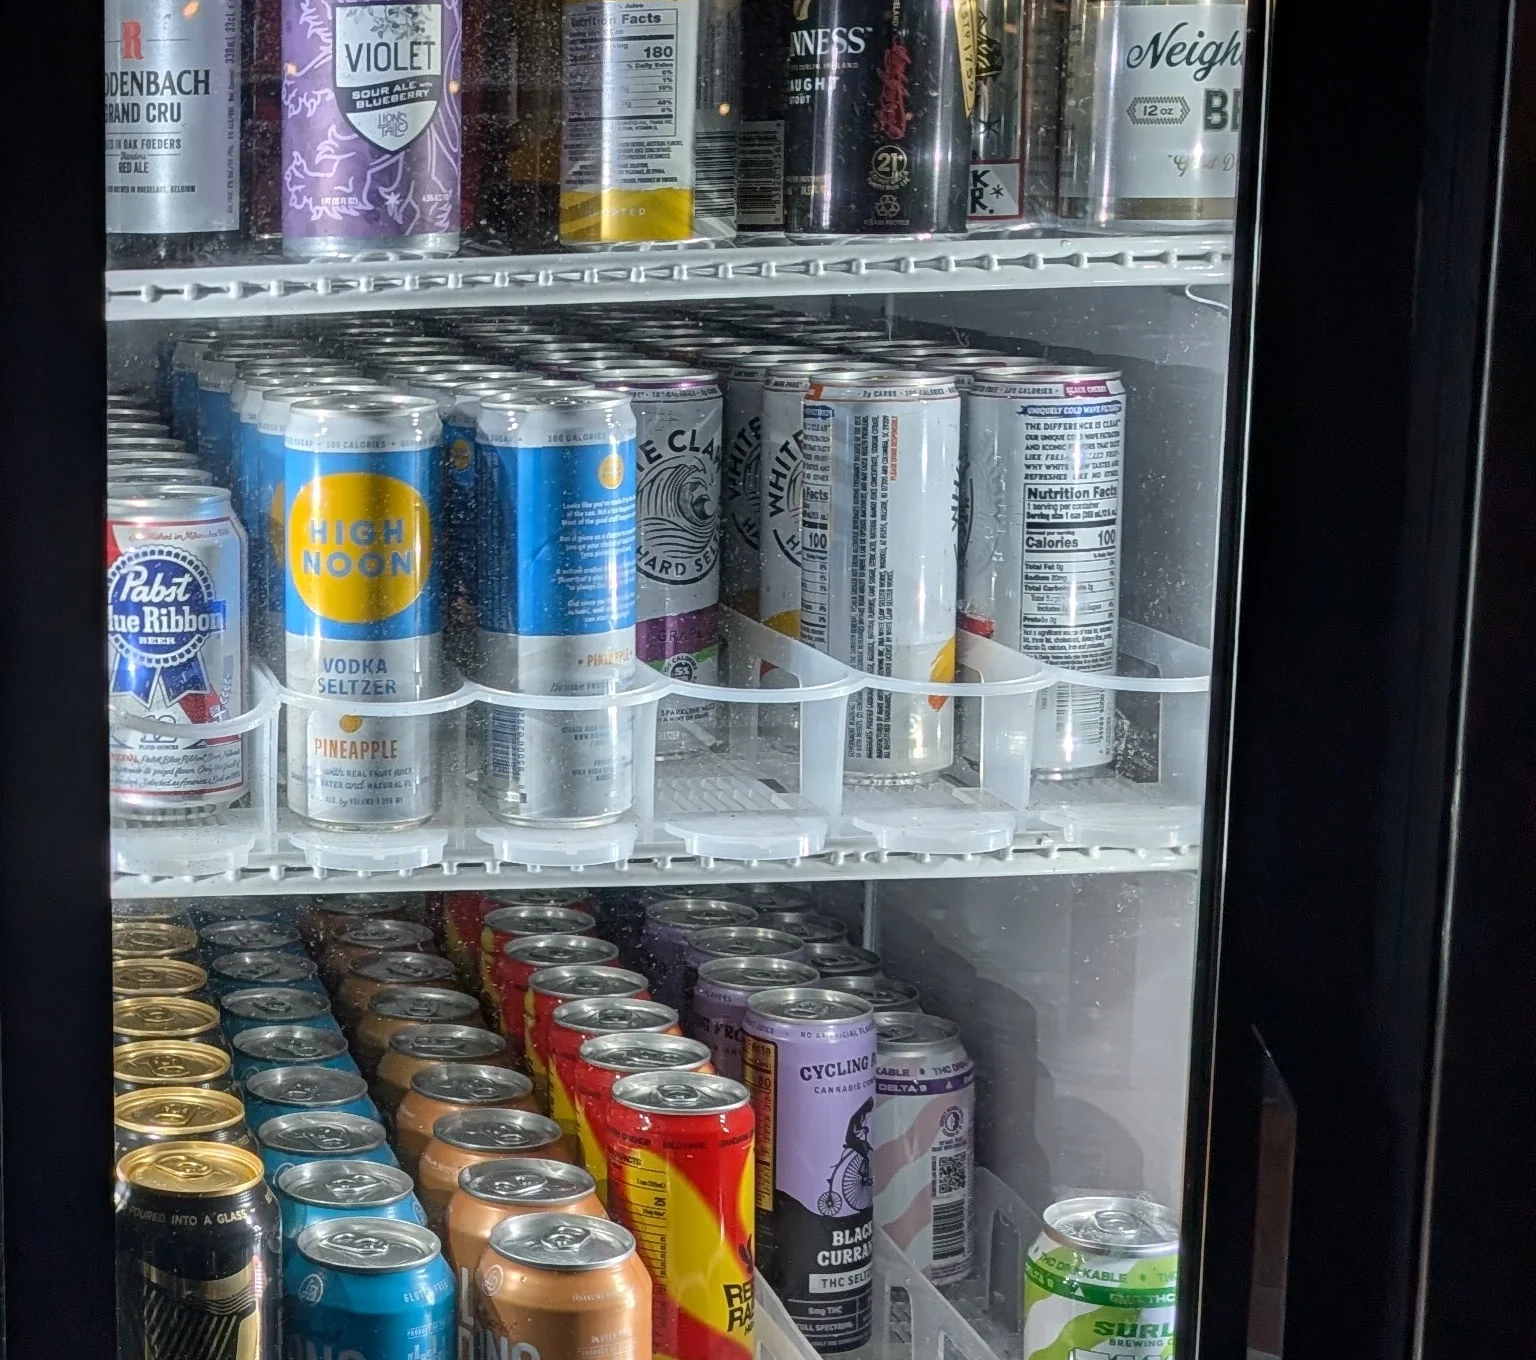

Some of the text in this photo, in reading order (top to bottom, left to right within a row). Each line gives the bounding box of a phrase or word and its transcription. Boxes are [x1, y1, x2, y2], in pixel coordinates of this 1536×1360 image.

[621, 13, 662, 25] Facts
[122, 20, 144, 60] R
[345, 42, 435, 72] VIOLET
[644, 46, 673, 59] 180
[352, 81, 416, 100] SOUR ALE
[356, 89, 429, 109] BLUEBERRY
[146, 102, 181, 123] CRU
[1143, 105, 1174, 117] 12 oz
[124, 139, 181, 150] OAK FOEDERS
[119, 162, 149, 173] RED ALE
[1018, 387, 1052, 395] CALORIES
[1028, 485, 1117, 500] Nutrition Facts
[1032, 504, 1058, 512] serving
[311, 520, 403, 546] HIGH
[1025, 529, 1115, 548] Calories 100
[809, 534, 827, 548] 100
[304, 550, 412, 577] NOON
[119, 564, 192, 603] Pabst
[142, 606, 224, 633] Ribbon
[139, 636, 175, 644] BEER
[323, 658, 387, 674] VODKA
[317, 678, 397, 695] SELTZER
[315, 738, 398, 760] PINEAPPLE
[325, 768, 344, 777] with
[369, 769, 391, 777] FRUIT
[345, 781, 365, 790] and
[800, 1056, 869, 1081] CYCLING
[932, 1066, 951, 1075] THC
[814, 1083, 861, 1094] CANNABIS
[879, 1084, 917, 1093] DELTA
[129, 1206, 248, 1225] POURED INTO A GLASS
[821, 1278, 844, 1289] THC
[827, 1306, 842, 1314] THC
[1109, 1339, 1163, 1348] BREWING
